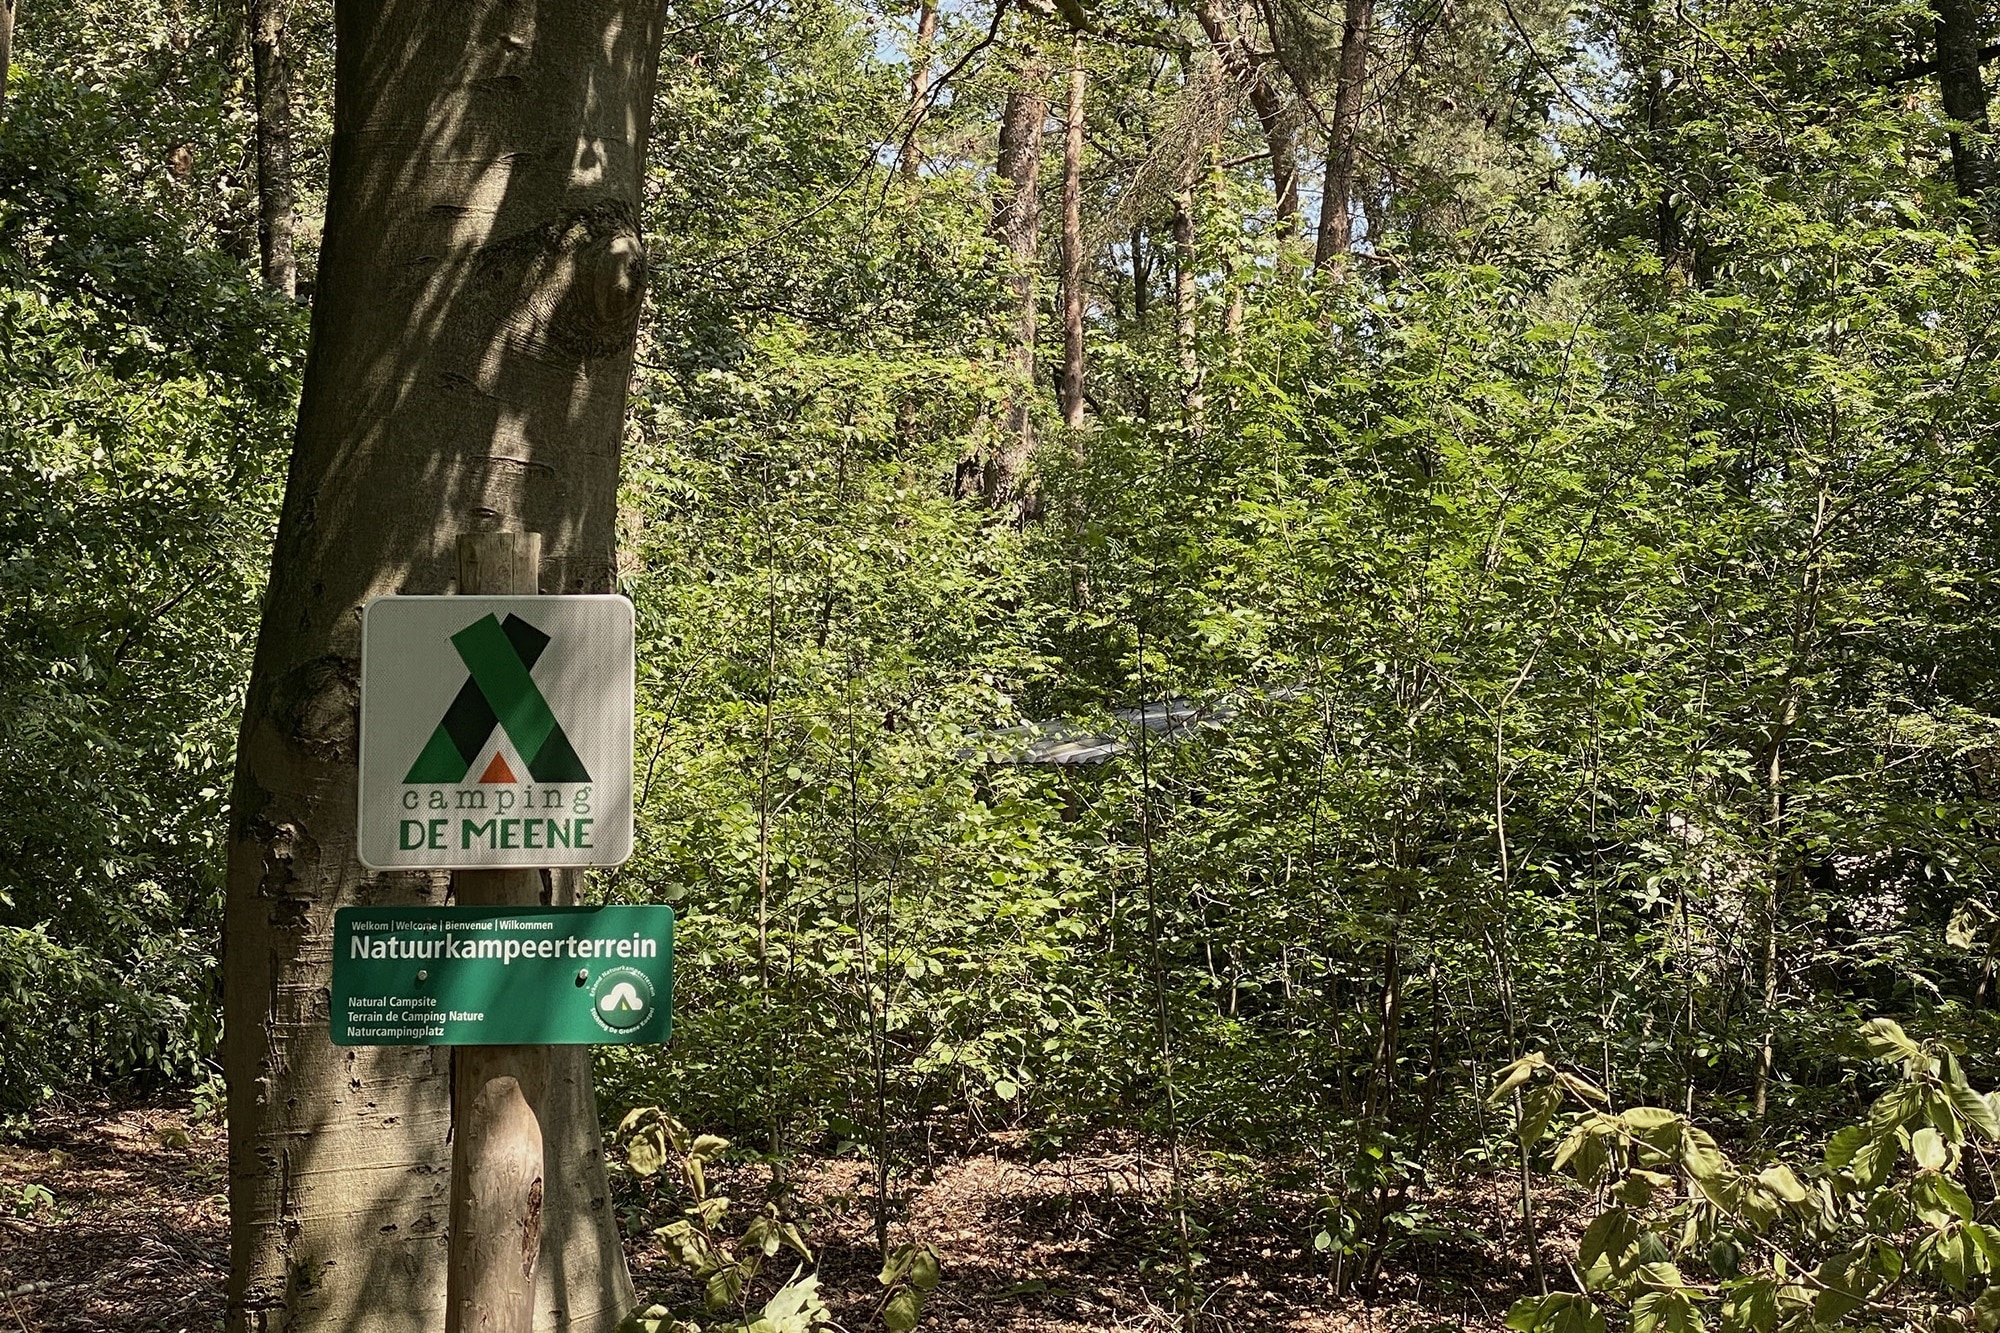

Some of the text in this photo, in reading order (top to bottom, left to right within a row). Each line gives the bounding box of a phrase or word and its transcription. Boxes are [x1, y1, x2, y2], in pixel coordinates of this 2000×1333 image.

[402, 785, 592, 815] camping
[400, 818, 594, 850] DE MEENE
[351, 919, 554, 931] Welkom Welcome Bienvenue Wilkommen
[350, 932, 657, 965] Natuurkampeerterrein
[348, 996, 437, 1009] Natural Campsite
[348, 1010, 485, 1024] Terrain de Camping Nature
[347, 1025, 445, 1039] Naturcampingplatz
